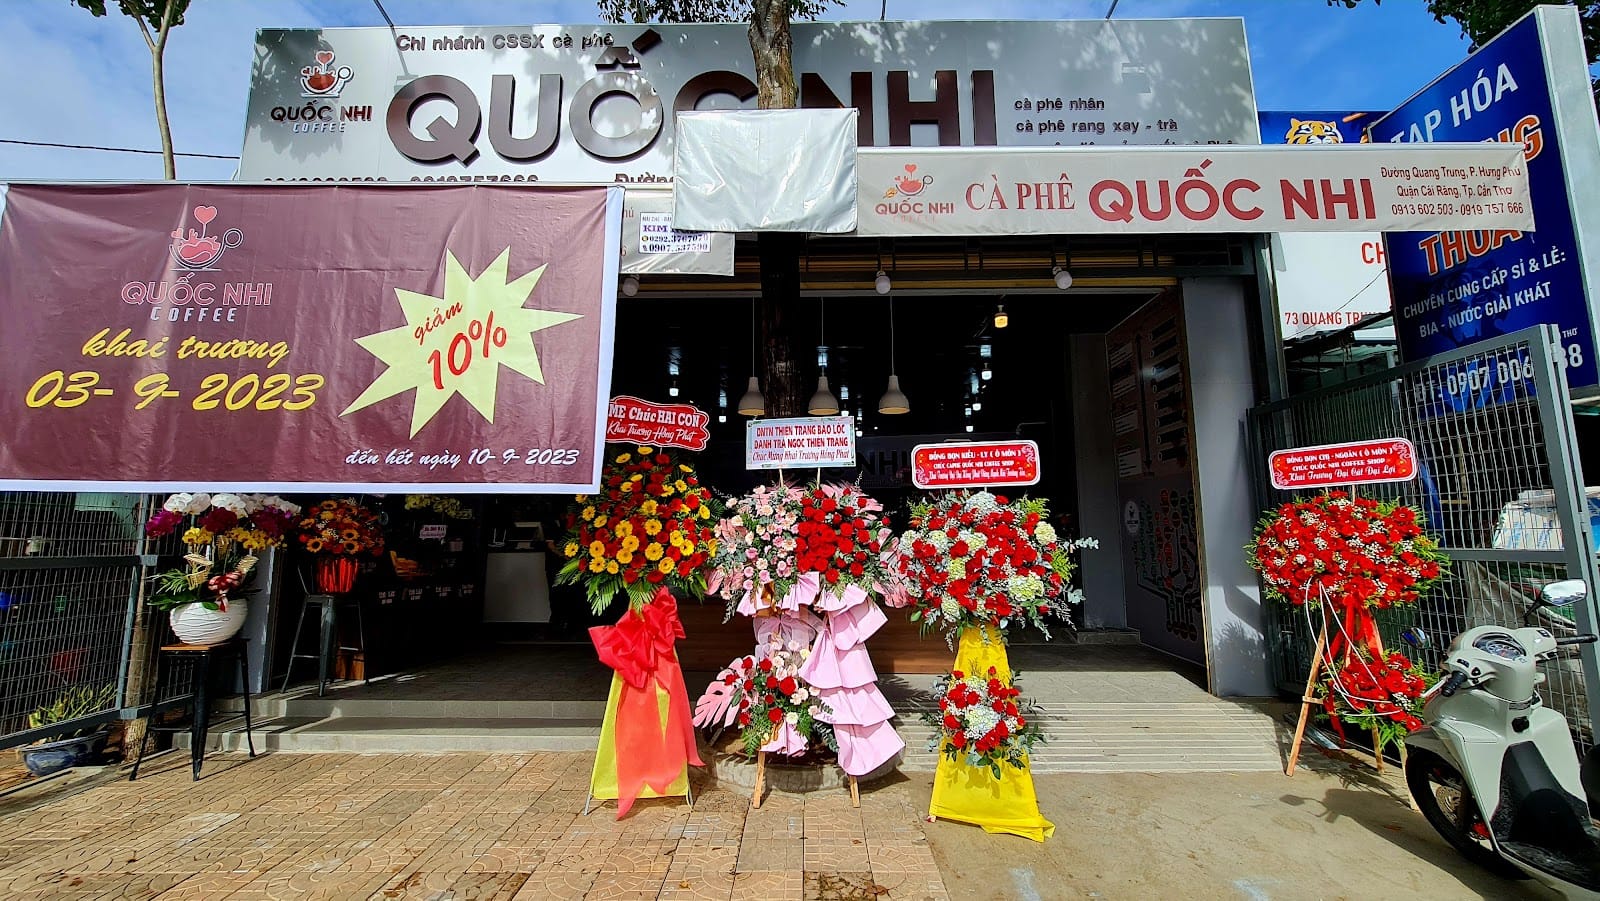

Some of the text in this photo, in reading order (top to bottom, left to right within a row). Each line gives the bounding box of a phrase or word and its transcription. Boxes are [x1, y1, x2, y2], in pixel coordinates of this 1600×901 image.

[432, 35, 485, 51] nhánh
[492, 34, 545, 49] CSSX
[552, 33, 573, 49] cà
[581, 33, 615, 51] phê
[1449, 63, 1519, 128] HÓA
[271, 100, 373, 123] QUỐC NHI
[1014, 97, 1105, 113] cà phê nhân
[292, 122, 346, 133] COFFEE
[1016, 120, 1034, 132] cà
[1038, 119, 1065, 135] phê
[1072, 122, 1106, 135] rang
[1113, 122, 1140, 135] xay
[1156, 119, 1178, 131] trà
[1381, 166, 1521, 180] Đường Quang Trung, P. Hưng Phú
[965, 173, 1076, 211] CÀ PHÊ
[1088, 158, 1377, 223] QUỐC NHI
[1397, 185, 1419, 199] Quận
[1421, 185, 1435, 196] Cái
[1462, 185, 1476, 198] Tp.
[1493, 185, 1513, 196] Thơ
[875, 197, 954, 215] QUỐC NHI
[1391, 204, 1416, 215] 0913
[1417, 204, 1435, 215] 602
[1437, 204, 1453, 215] 503
[1460, 204, 1483, 215] 0919
[1485, 203, 1504, 214] 757
[1507, 202, 1524, 214] 666
[642, 224, 668, 232] KIM
[121, 271, 273, 305] QUỐC NHI
[1403, 294, 1445, 319] CHUYÊN
[1447, 280, 1480, 303] CUNG
[1482, 267, 1508, 290] CẤP
[1528, 258, 1541, 273] &
[150, 306, 238, 322] COFFEE
[1284, 312, 1298, 325] 73
[1302, 311, 1342, 325] QUANG
[1419, 322, 1439, 338] BIA
[1448, 306, 1483, 329] NƯỚC
[1484, 294, 1512, 316] GIẢI
[1514, 281, 1551, 307] KHÁT
[414, 302, 463, 346] giảm
[81, 327, 289, 368] khai trương
[427, 310, 507, 390] 10%
[192, 372, 325, 411] 2023
[608, 403, 700, 428] MẸ Chúc HAI CON
[607, 420, 627, 435] Khai
[795, 424, 816, 435] TRANG
[754, 439, 772, 449] DANH
[827, 437, 849, 447] TRANG
[345, 448, 380, 464] đến
[385, 448, 414, 464] hết
[419, 450, 462, 470] ngày
[525, 448, 580, 465] 2023
[1341, 459, 1365, 467] COFFEE
